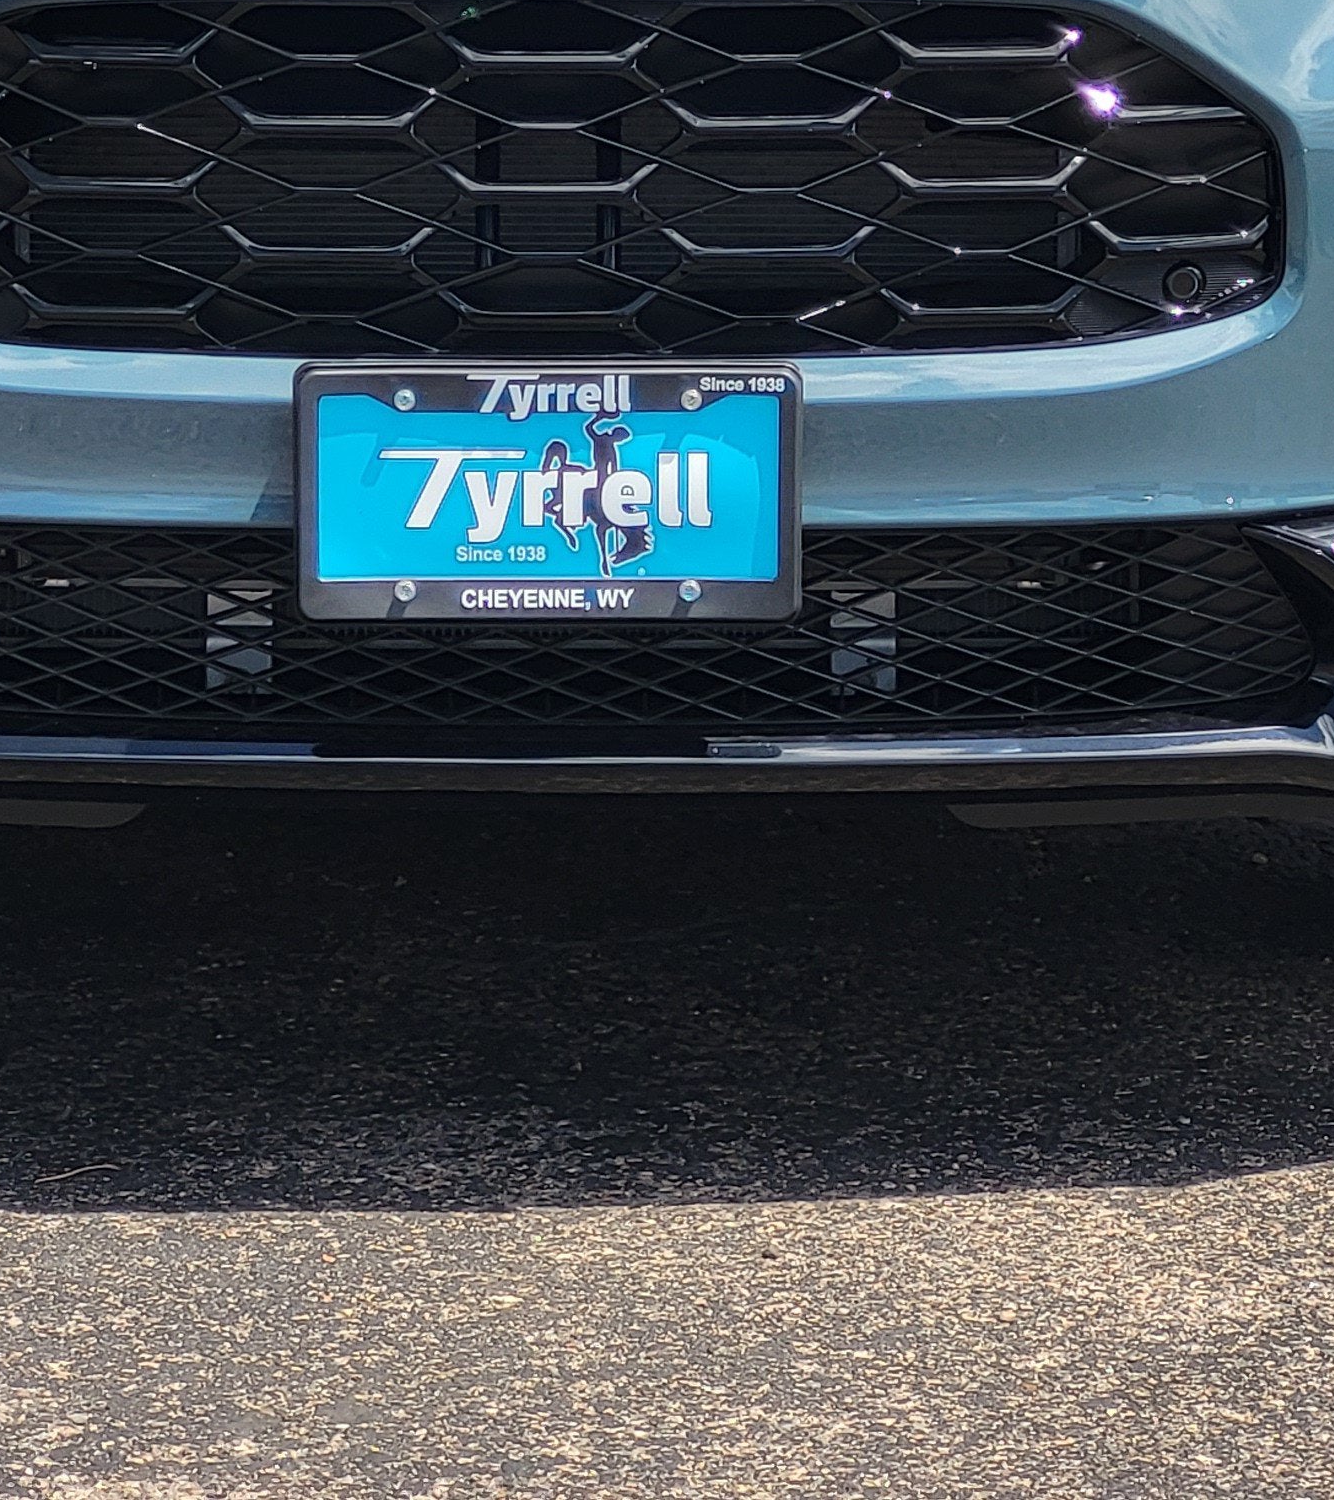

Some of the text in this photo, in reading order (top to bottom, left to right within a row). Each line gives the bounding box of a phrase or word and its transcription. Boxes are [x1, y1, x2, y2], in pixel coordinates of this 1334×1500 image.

[699, 376, 786, 393] Since 1938
[466, 374, 631, 421] Tyrrell
[378, 449, 713, 543] Tyrrell
[455, 545, 547, 562] Since 1938
[460, 588, 635, 610] CHEYENNE, WY
